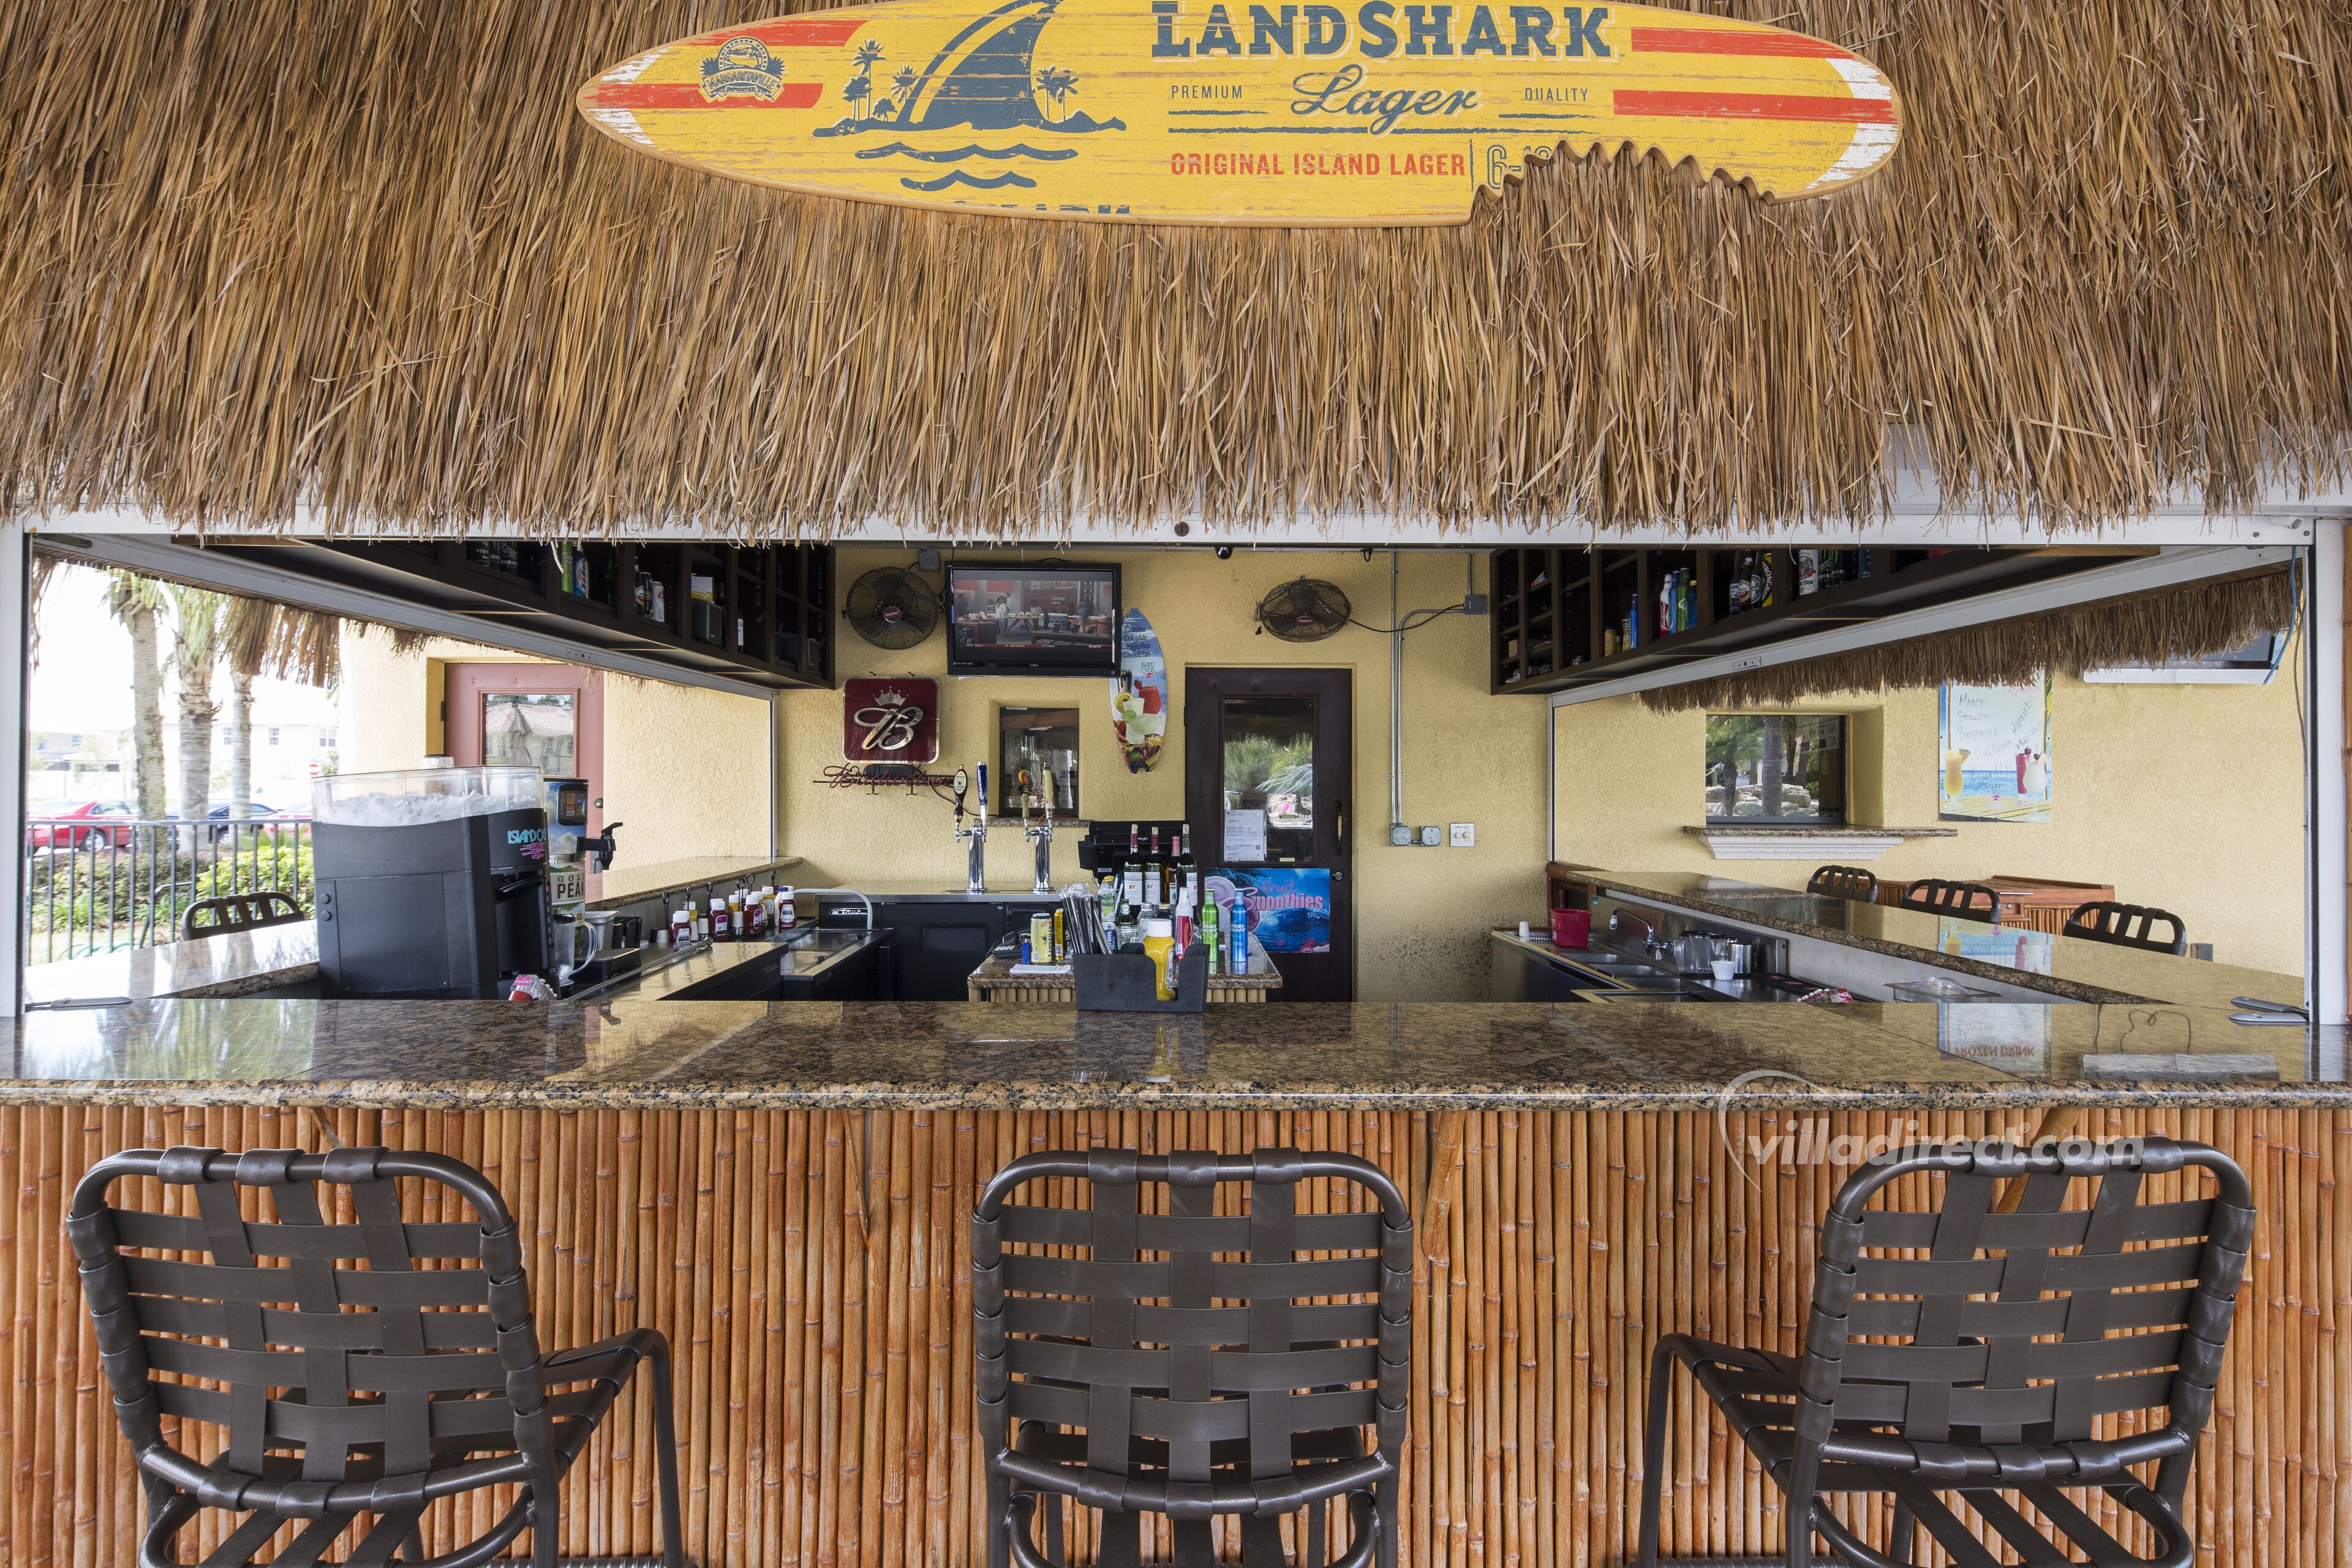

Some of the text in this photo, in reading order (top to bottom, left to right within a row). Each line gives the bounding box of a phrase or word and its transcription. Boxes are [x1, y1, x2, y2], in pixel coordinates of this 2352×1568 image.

[1152, 0, 1611, 58] LANDSHARK
[707, 71, 777, 90] MARGARITAVILLE
[1171, 85, 1243, 99] PREMIUM
[1290, 64, 1478, 135] Lager
[1524, 88, 1588, 102] QUALITY
[1171, 152, 1465, 176] ORIGINAL ISLAND LAGER
[823, 765, 954, 788] Budweiser
[507, 829, 537, 844] ISLAND
[1262, 878, 1298, 894] fruit
[1227, 886, 1324, 913] Smoothies
